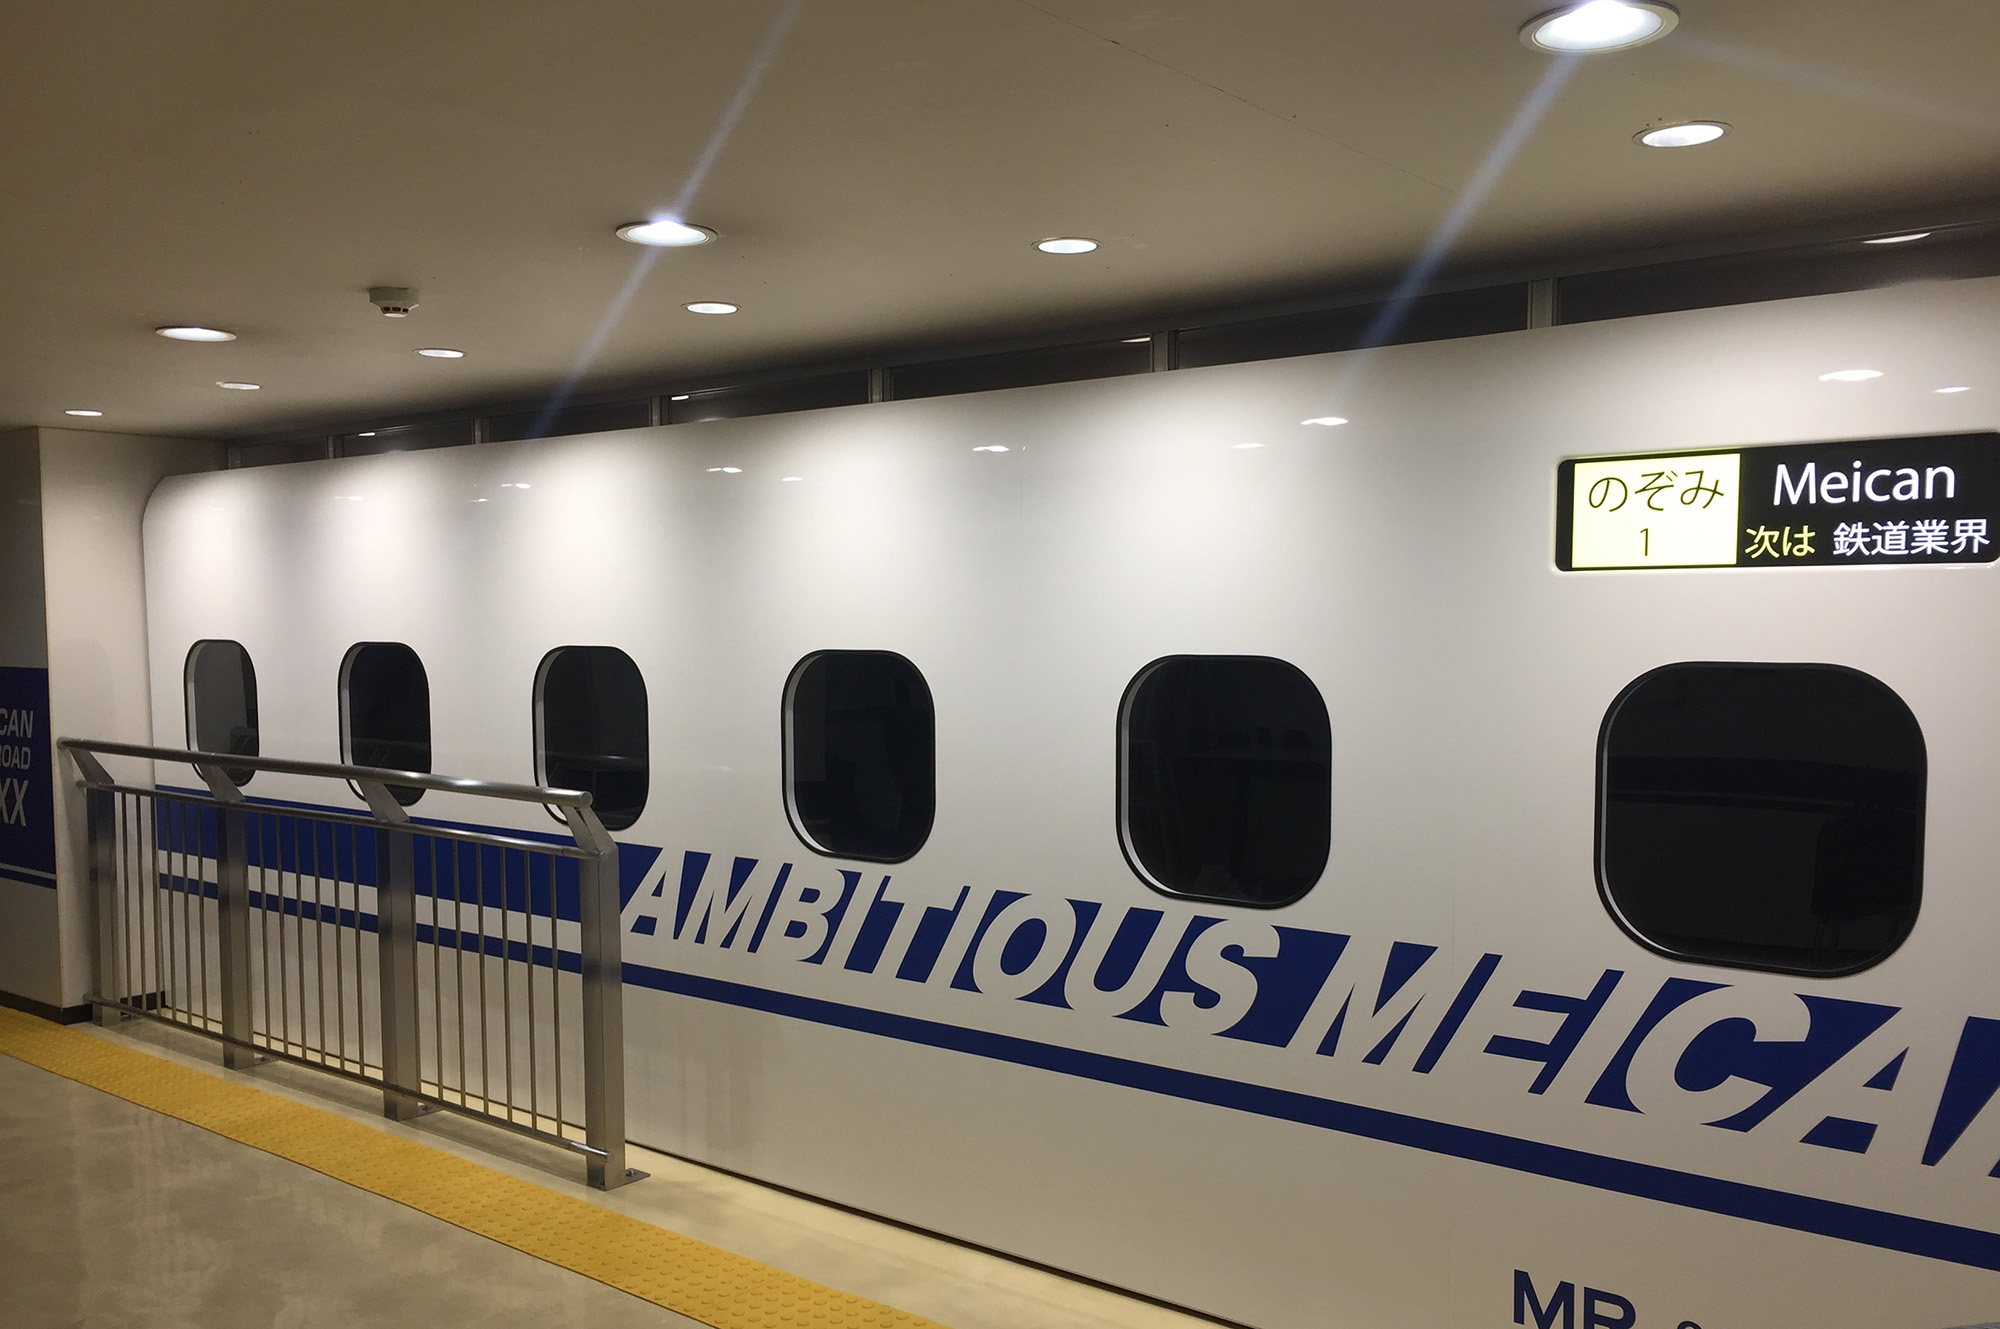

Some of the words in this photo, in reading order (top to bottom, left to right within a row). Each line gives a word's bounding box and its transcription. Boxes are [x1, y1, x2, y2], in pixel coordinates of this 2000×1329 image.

[1588, 470, 1725, 513] のぞみ
[1773, 460, 1957, 506] Meican
[1638, 527, 1651, 557] 1
[1744, 522, 1816, 560] 次は
[1832, 518, 1991, 557] 鉄道業界
[0, 744, 31, 770] OAD
[617, 846, 1282, 1035] AMBITIOUS
